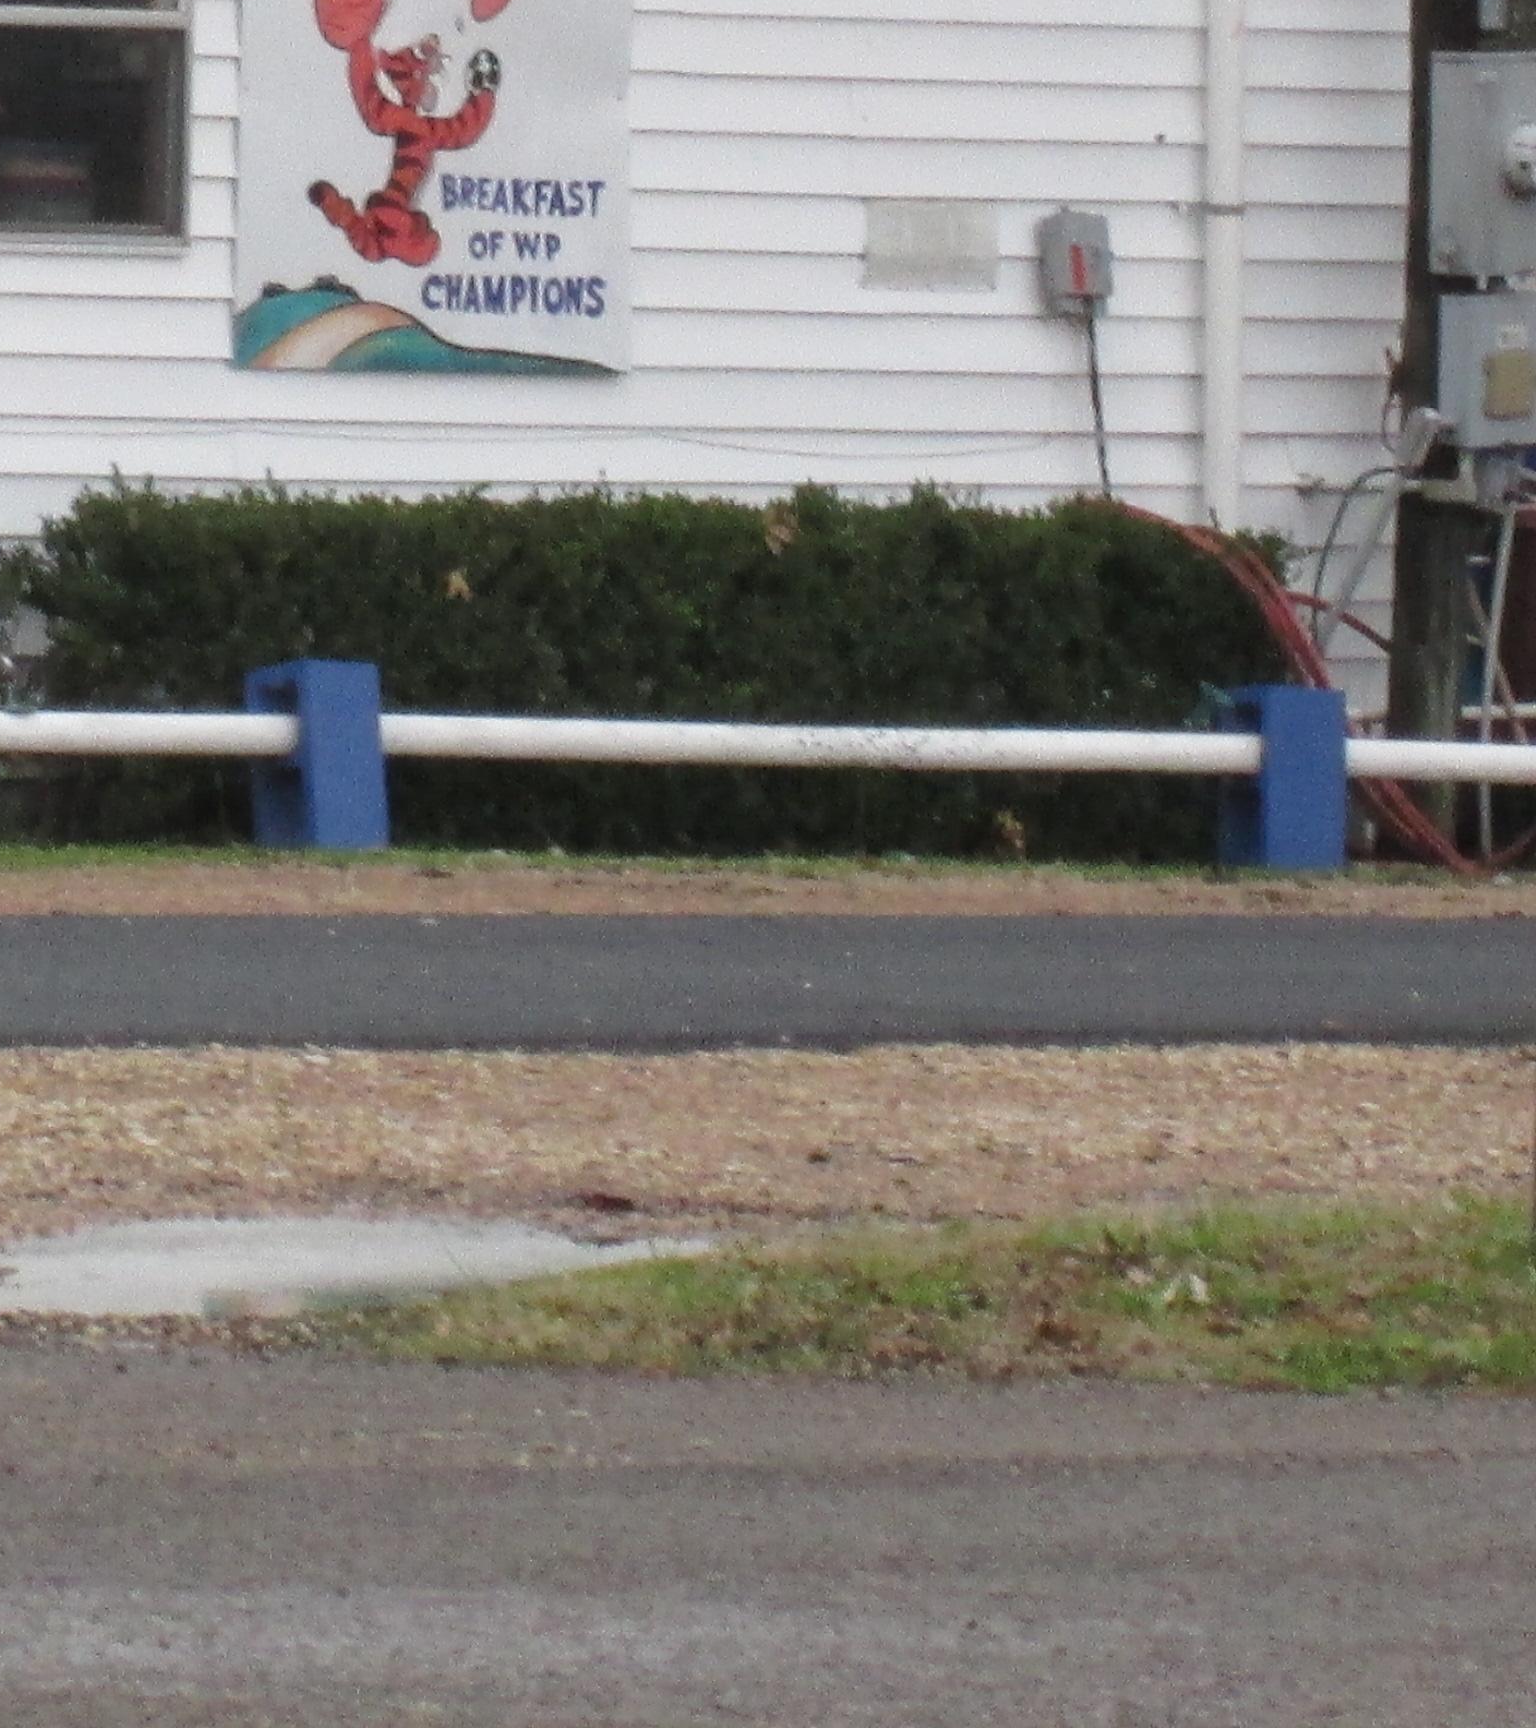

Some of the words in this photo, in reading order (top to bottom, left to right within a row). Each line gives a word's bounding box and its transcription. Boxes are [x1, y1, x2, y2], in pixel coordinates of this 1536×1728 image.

[441, 174, 605, 217] BREAKFAST
[468, 231, 504, 261] OF
[513, 231, 561, 261] WP
[421, 274, 607, 317] CHAMPIONS
